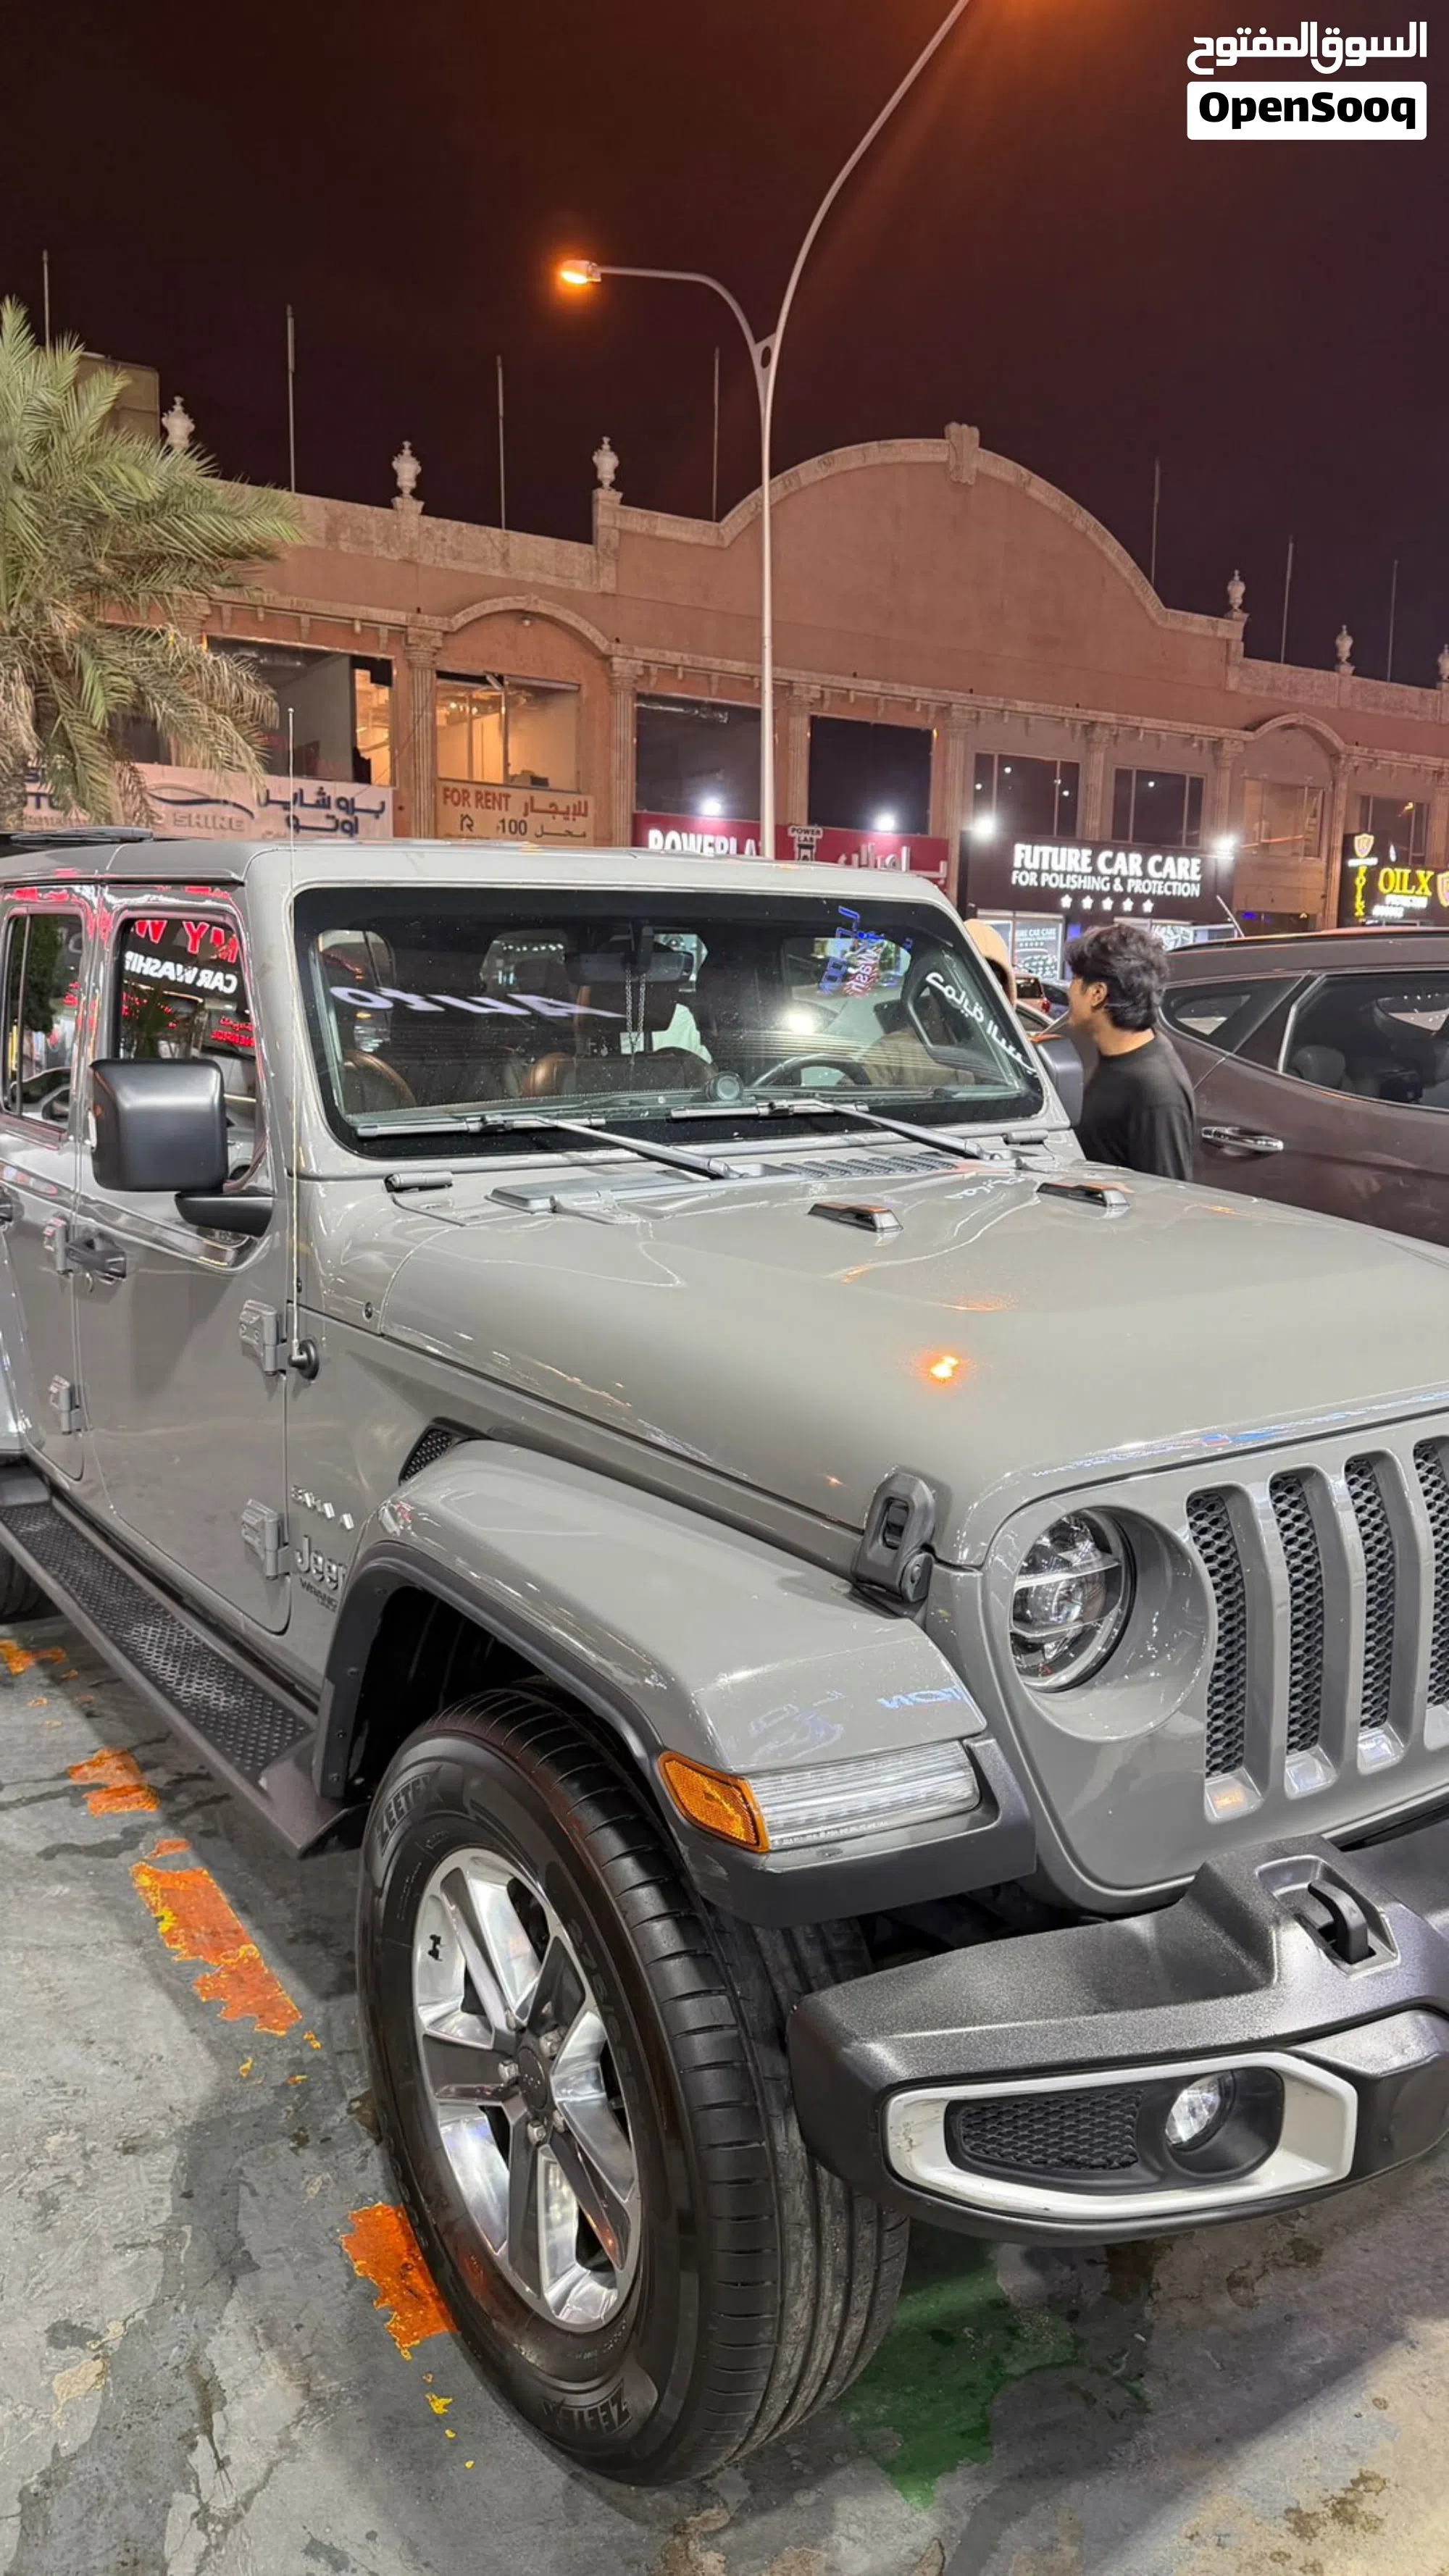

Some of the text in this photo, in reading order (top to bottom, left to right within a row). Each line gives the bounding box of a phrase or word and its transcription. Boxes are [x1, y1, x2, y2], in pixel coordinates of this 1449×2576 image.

[442, 787, 511, 812] FOR RENT
[173, 812, 246, 832] SHINE
[648, 829, 763, 858] POWERLA
[1013, 842, 1202, 881] FUTURE CAR CARE
[1011, 870, 1200, 898] FOR POLISHING & PROTECTION
[1378, 867, 1435, 898] OILX
